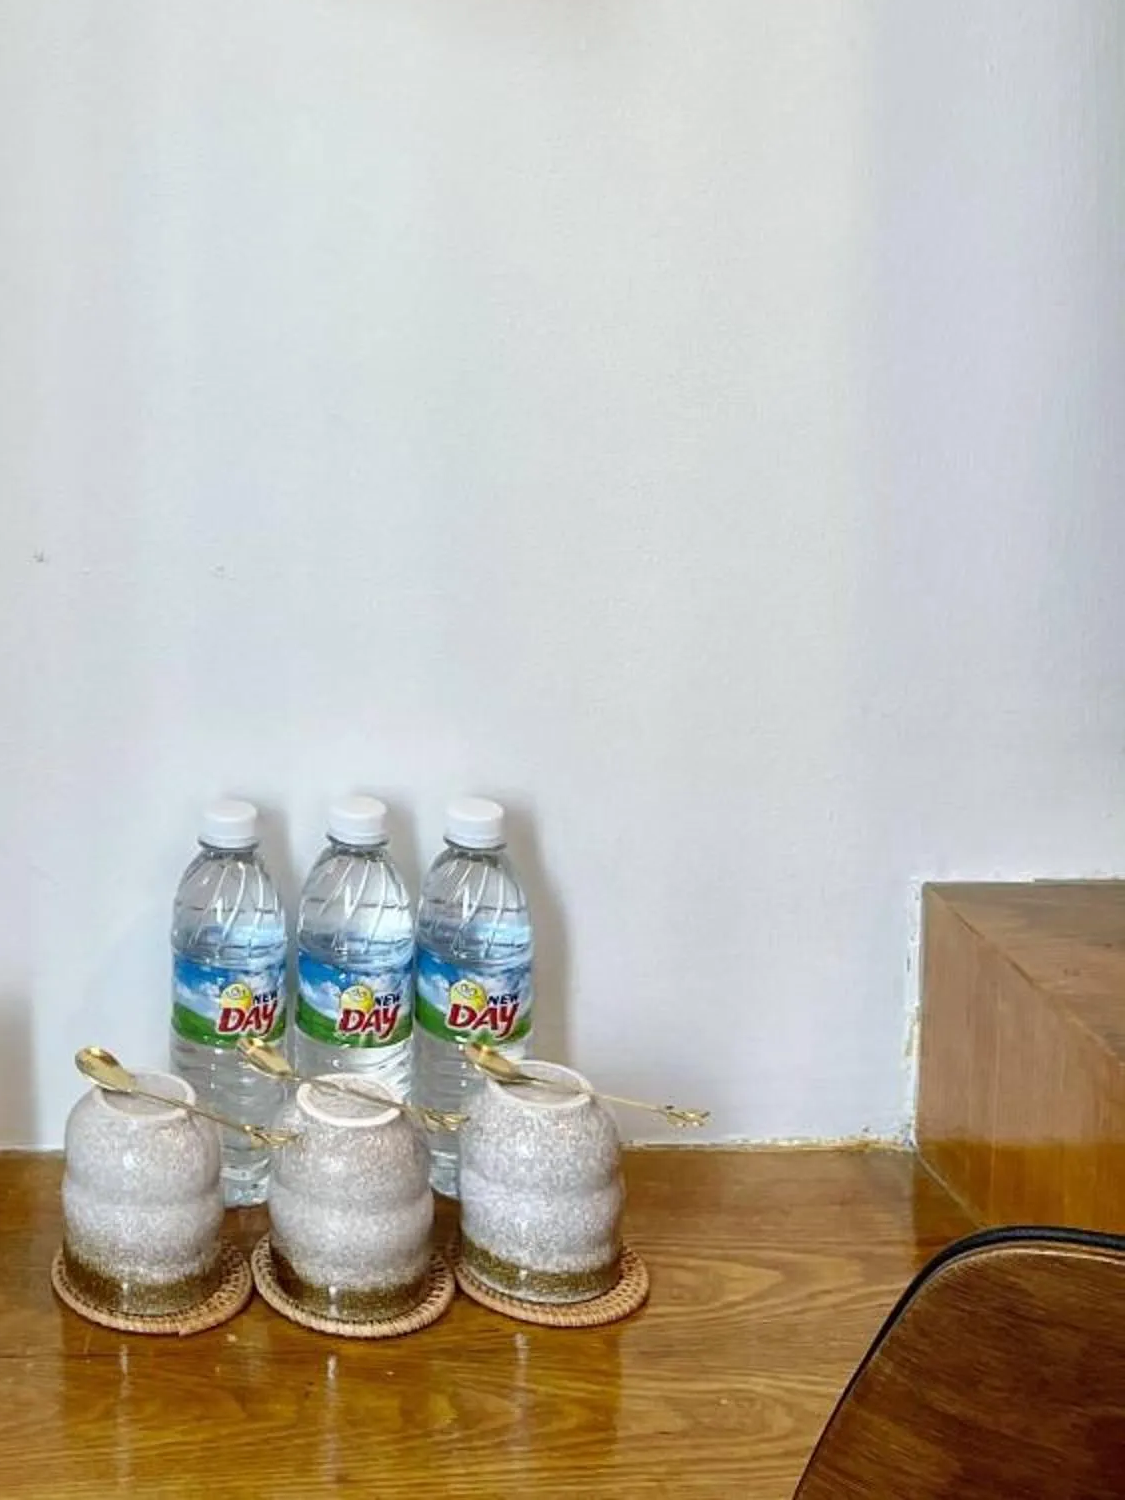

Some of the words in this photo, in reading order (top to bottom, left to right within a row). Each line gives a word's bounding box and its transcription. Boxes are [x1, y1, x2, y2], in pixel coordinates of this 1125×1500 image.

[218, 1000, 278, 1036] DAY
[339, 1004, 402, 1040] DAY
[448, 1003, 520, 1038] DAY
